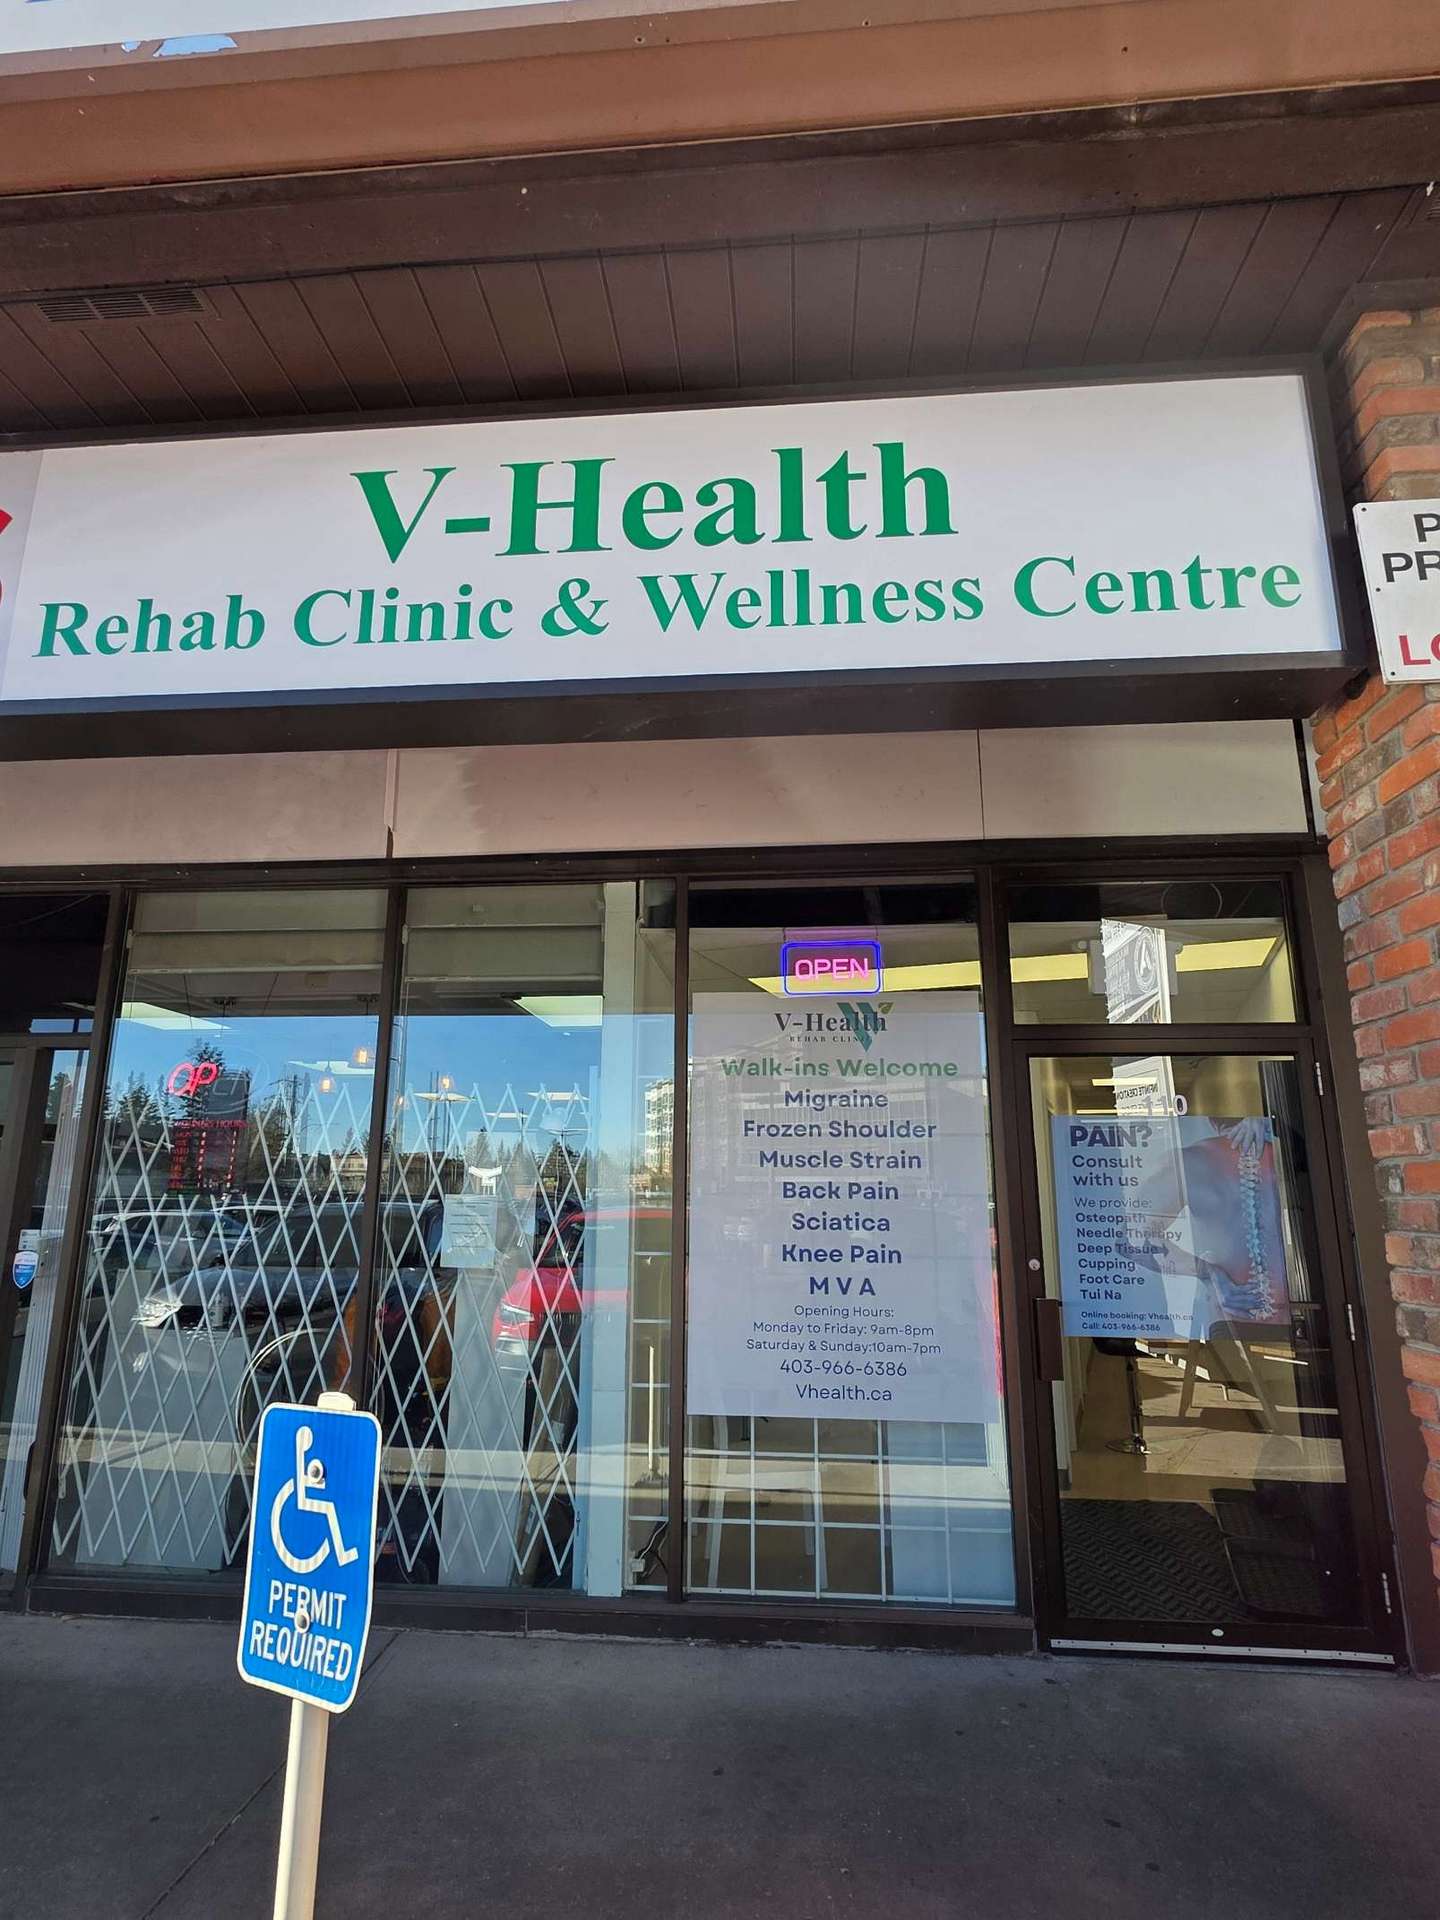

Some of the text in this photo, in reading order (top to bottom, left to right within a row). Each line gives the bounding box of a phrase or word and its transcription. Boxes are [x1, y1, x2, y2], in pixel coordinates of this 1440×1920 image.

[350, 442, 959, 564] V-Health
[31, 554, 1302, 658] Rehab Clinic & Wellness Centre
[793, 957, 870, 981] OPEN
[774, 1011, 888, 1032] V-Health
[721, 1058, 958, 1077] Walk-ins Welcome
[784, 1089, 889, 1111] Migraine
[743, 1120, 937, 1139] Frozen Shoulder
[1070, 1124, 1153, 1147] PAIN?
[759, 1150, 922, 1170] Muscle Strain
[1072, 1154, 1143, 1169] Consult
[1073, 1171, 1139, 1187] with us
[782, 1181, 899, 1201] Back Pain
[1074, 1197, 1152, 1211] We provide:
[791, 1212, 891, 1232] Sciatica
[1075, 1212, 1147, 1226] Osteopath
[1076, 1228, 1124, 1239] Needle
[782, 1244, 902, 1264] Knee Pain
[1077, 1243, 1158, 1255] Deep Tissue
[1078, 1258, 1136, 1272] Cupping
[1079, 1274, 1145, 1286] Foot Care
[1080, 1289, 1122, 1301] Tui Na
[794, 1305, 894, 1319] Opening Hours:
[1080, 1311, 1108, 1319] Online
[1109, 1311, 1147, 1321] booking:
[753, 1322, 935, 1337] Monday to Friday: 9am-8pm
[1082, 1321, 1161, 1332] Call: 403-966-6386
[746, 1338, 805, 1352] Saturday
[808, 1340, 817, 1351] &
[779, 1359, 908, 1377] 403-966-6386
[795, 1384, 893, 1401] Vhealth.ca
[268, 1580, 347, 1629] PERMIT
[249, 1620, 353, 1682] REQUIRED
